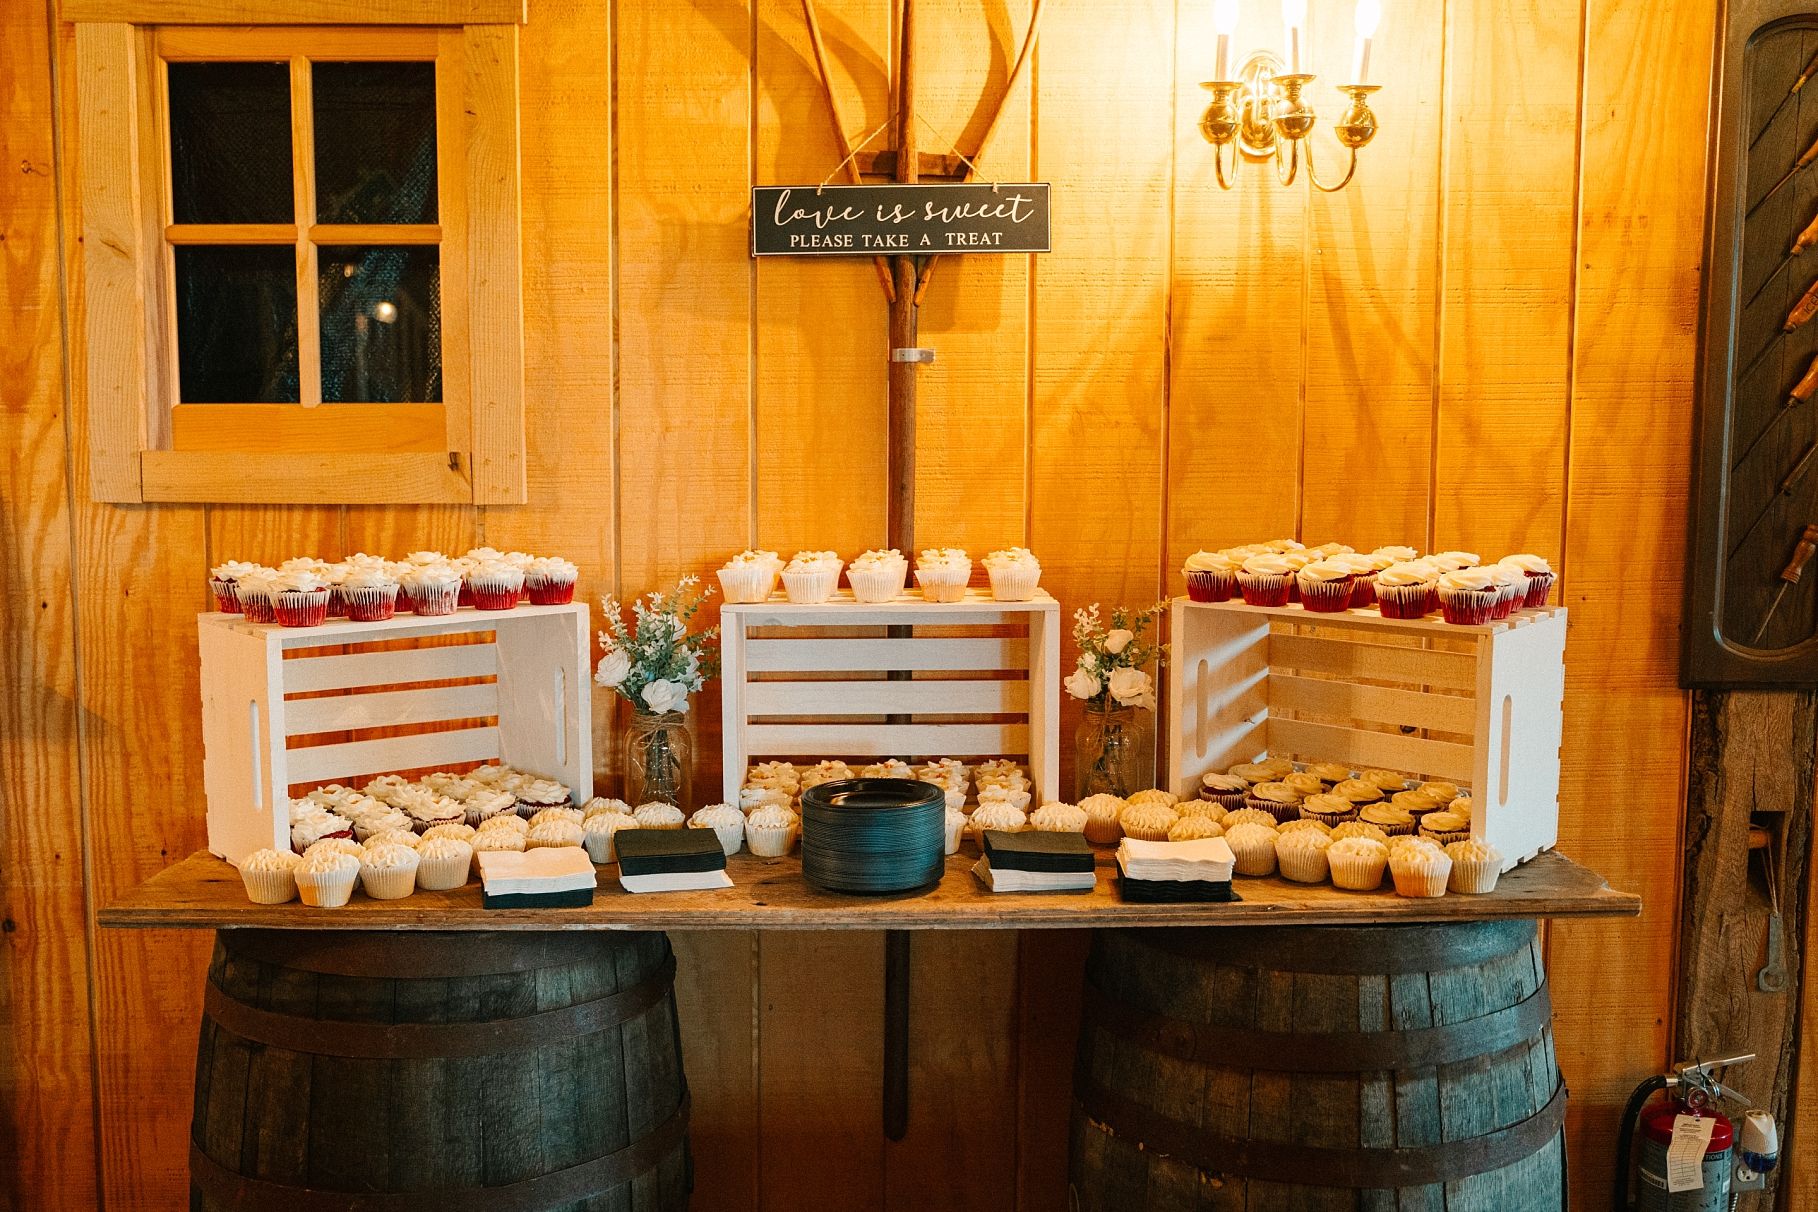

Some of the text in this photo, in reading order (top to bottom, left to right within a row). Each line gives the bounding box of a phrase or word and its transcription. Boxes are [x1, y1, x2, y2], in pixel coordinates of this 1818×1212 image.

[774, 189, 1035, 229] love is sweet
[790, 232, 1003, 248] PLEASE TAKE A TREAT
